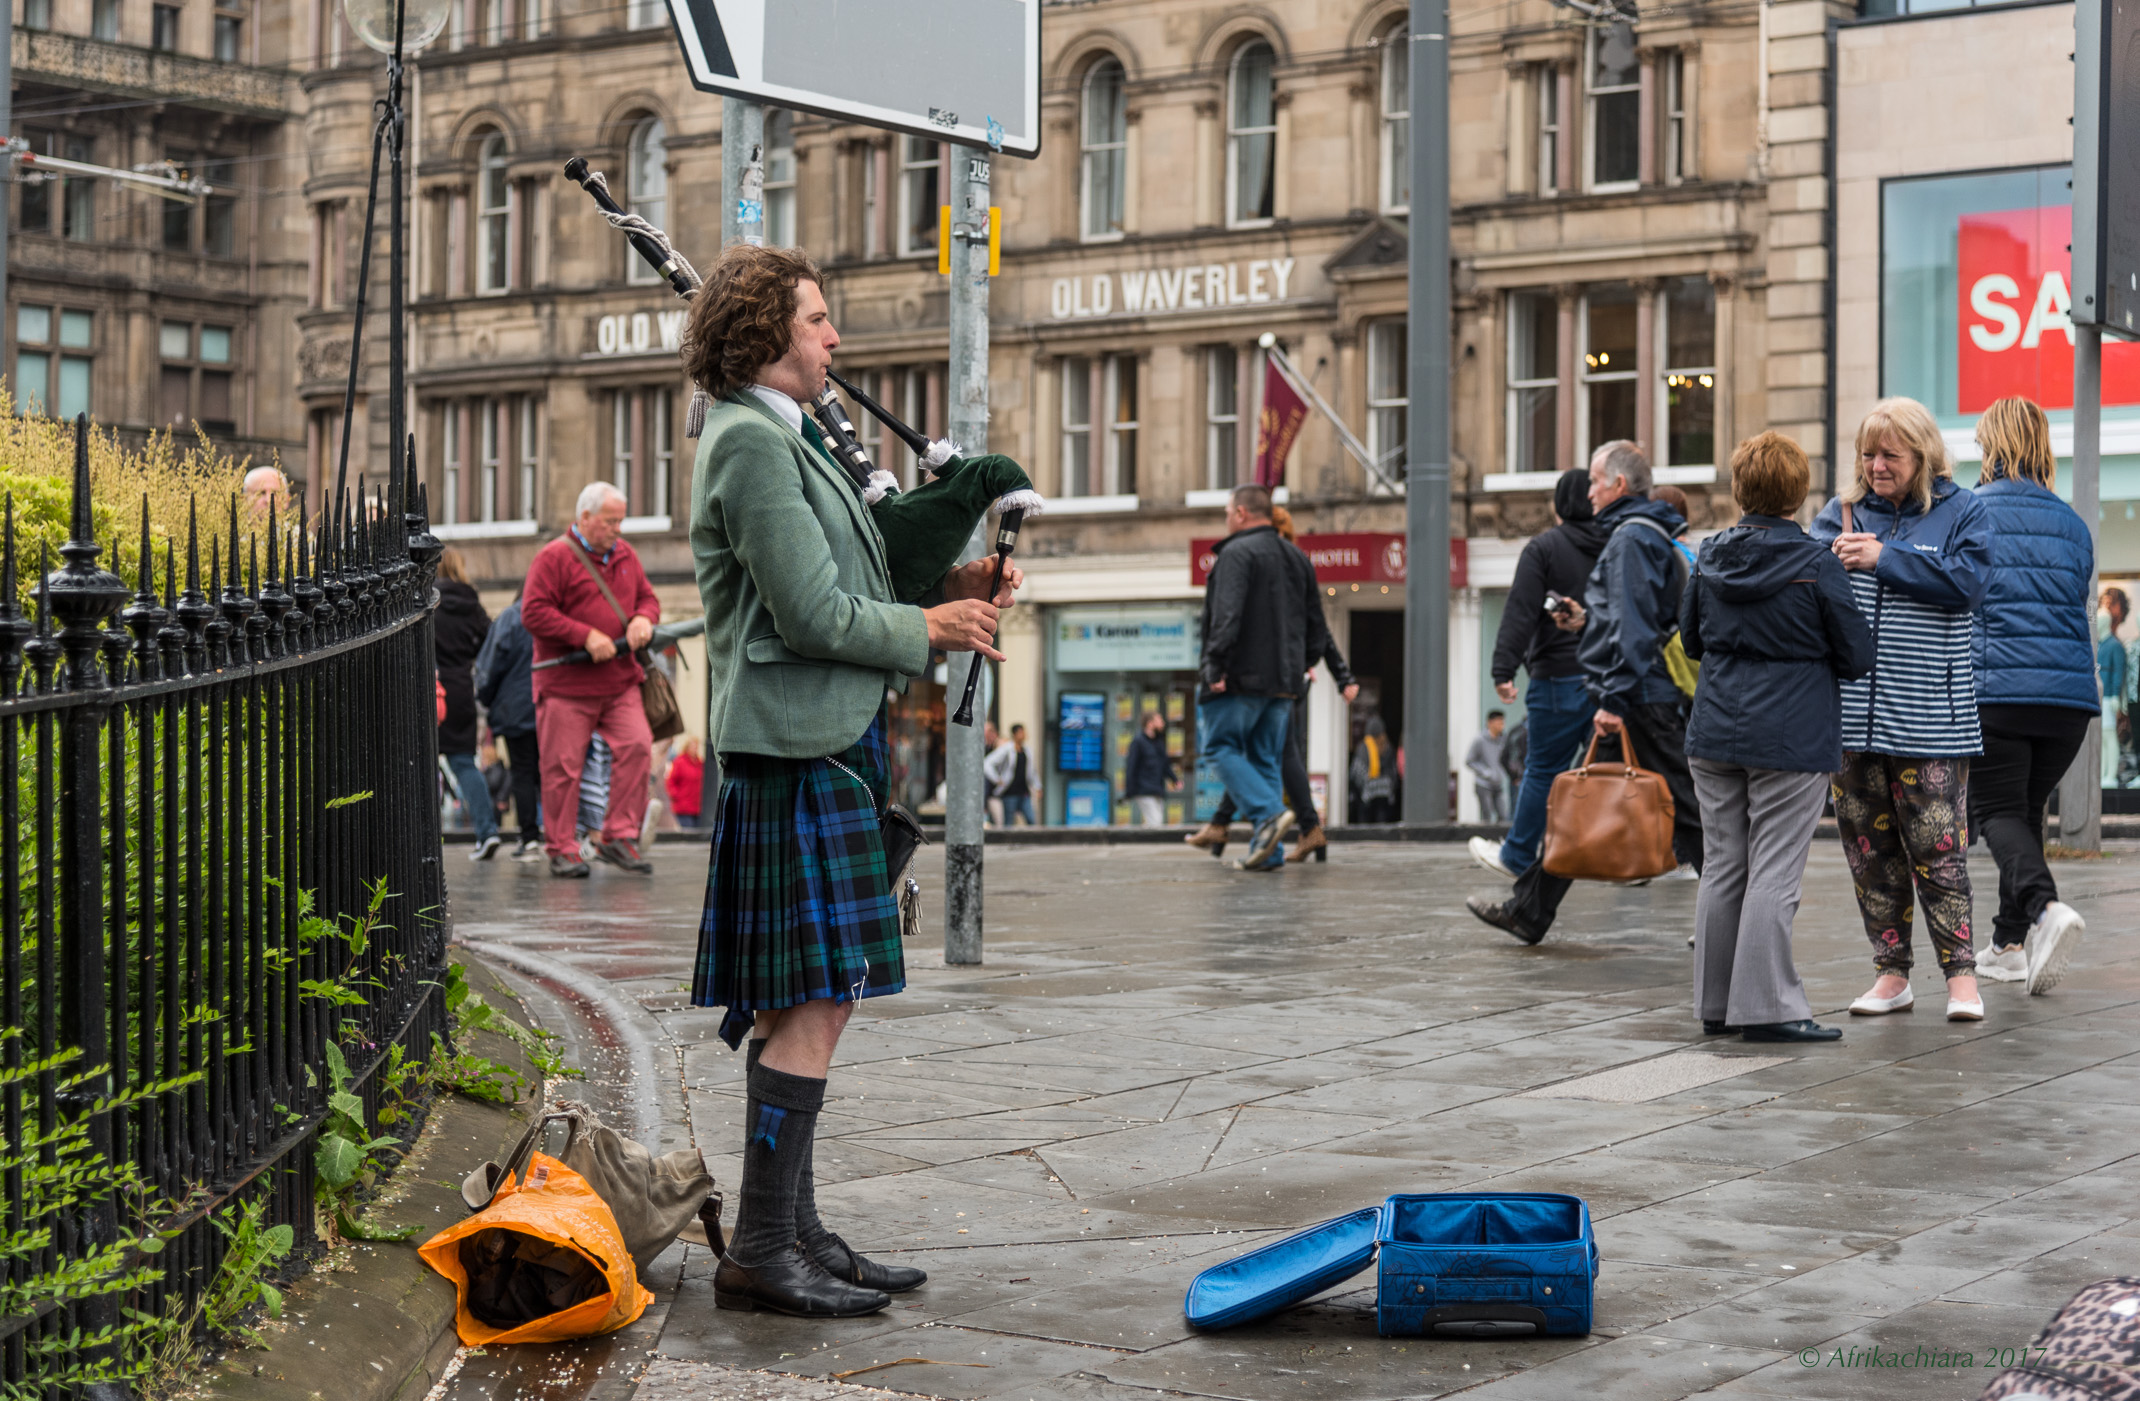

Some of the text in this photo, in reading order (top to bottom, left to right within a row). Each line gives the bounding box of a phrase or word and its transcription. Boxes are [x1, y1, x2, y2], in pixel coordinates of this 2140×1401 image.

[1052, 258, 1295, 319] OLD WAVERLEY
[598, 313, 650, 354] OLD
[1310, 549, 1359, 567] HOTEL
